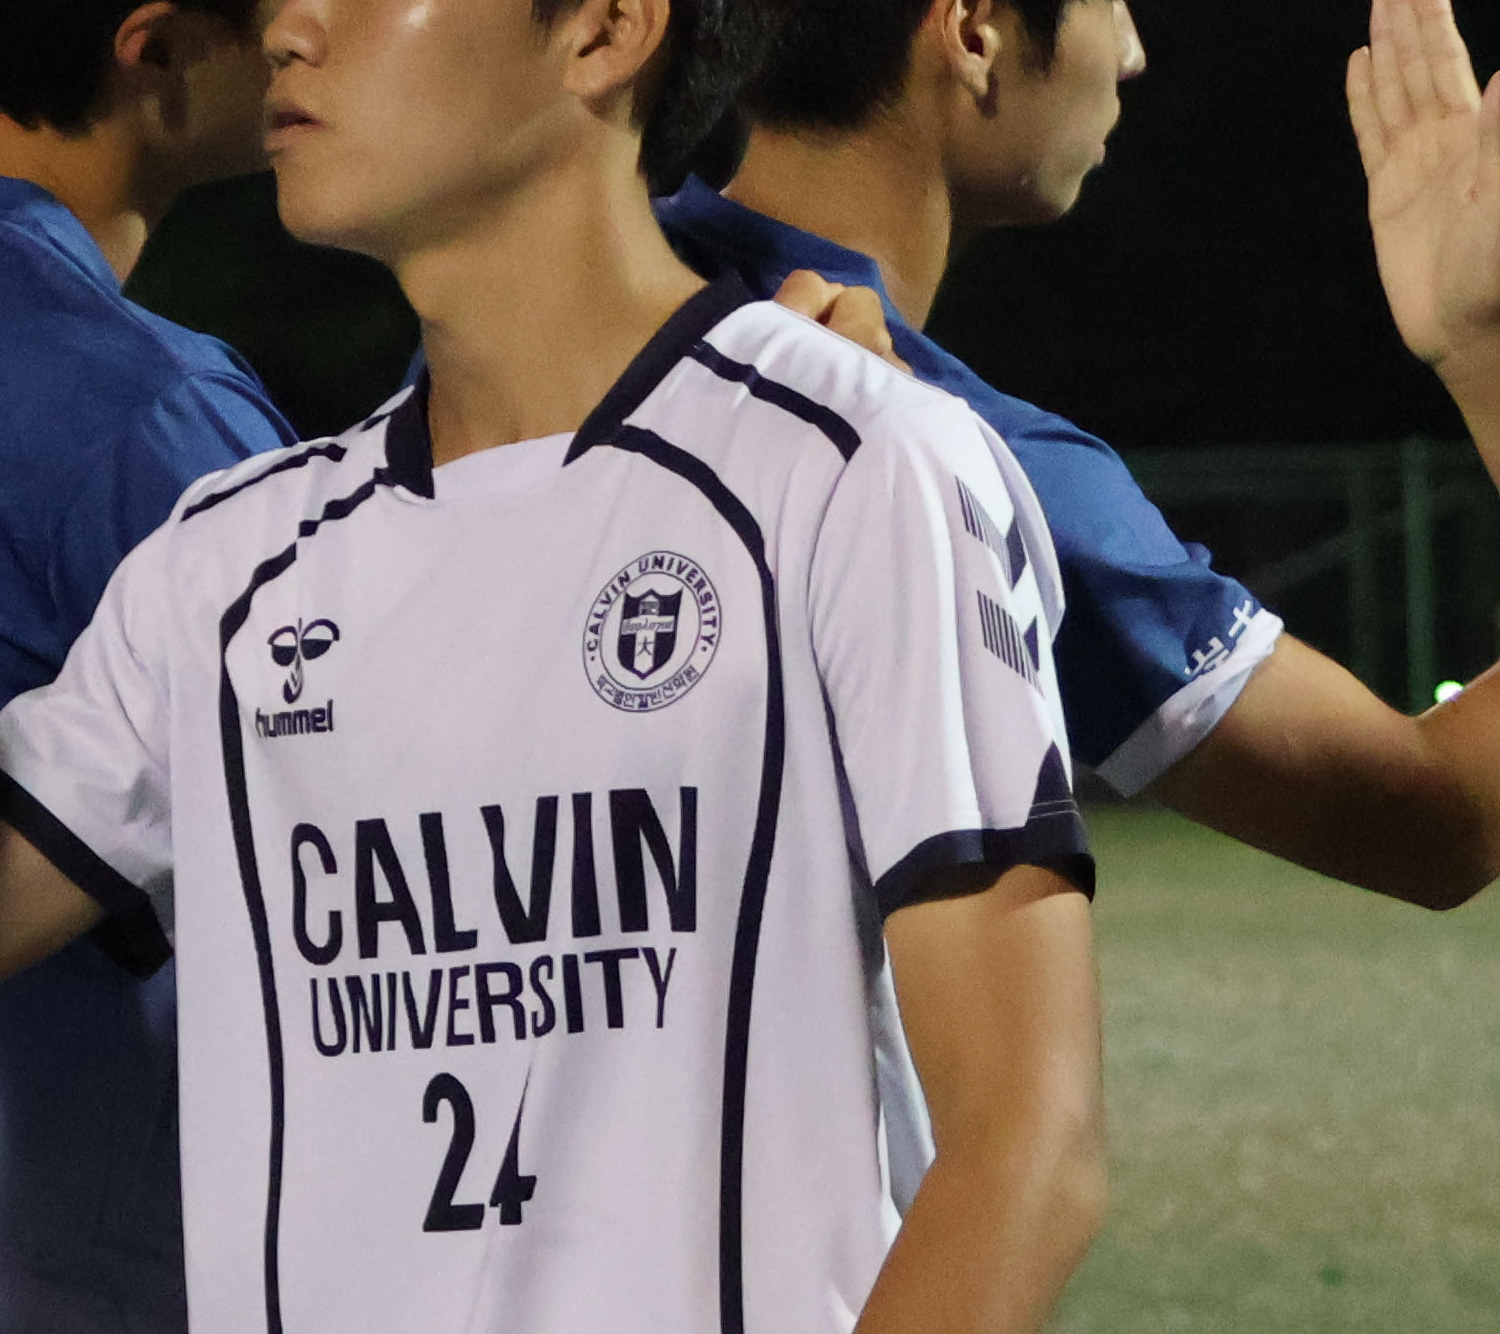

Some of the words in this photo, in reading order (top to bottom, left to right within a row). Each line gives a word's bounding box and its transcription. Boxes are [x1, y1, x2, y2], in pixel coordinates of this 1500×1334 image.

[586, 569, 631, 652] CALVIN
[638, 554, 717, 647] UNIVERSITY
[255, 699, 334, 738] hummel
[290, 786, 698, 966] CALVIN
[309, 946, 677, 1058] UNIVERSITY
[422, 1072, 538, 1233] 24
